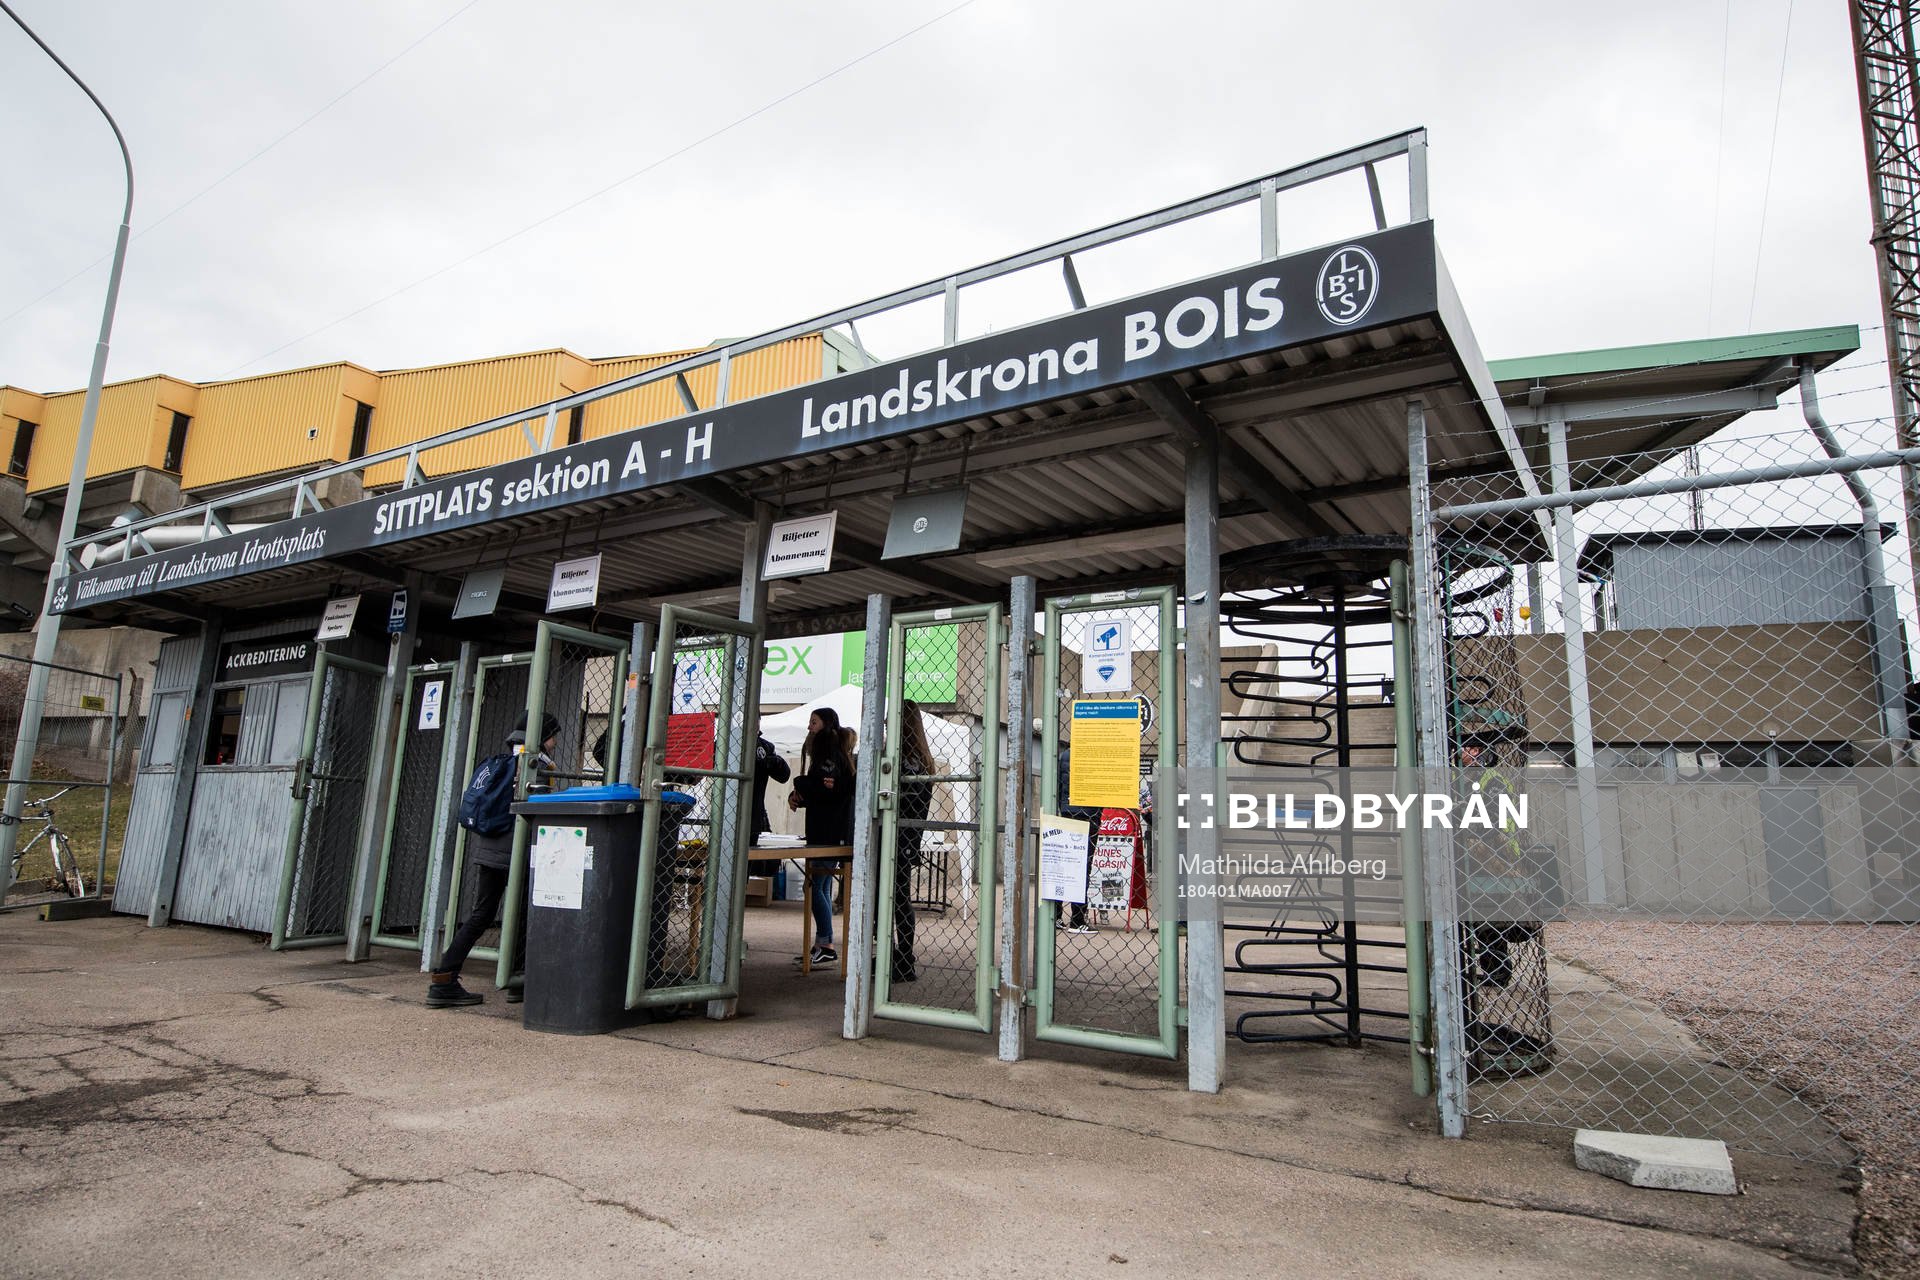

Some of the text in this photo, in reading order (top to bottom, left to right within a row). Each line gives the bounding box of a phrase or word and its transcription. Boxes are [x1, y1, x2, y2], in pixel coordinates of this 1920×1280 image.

[801, 277, 1284, 438] Landskrona BOIS
[374, 478, 493, 534] SITTPLATS
[501, 456, 609, 506] sektion
[621, 441, 647, 479] A
[685, 422, 713, 464] H
[781, 529, 820, 543] Biljetter
[75, 527, 327, 601] Välkommen till Landskrona Idrottsplats
[770, 548, 826, 563] Abonnemang
[560, 568, 589, 580] Biljetter
[553, 585, 593, 598] Abonnemang
[226, 644, 306, 669] ACKREDITERING
